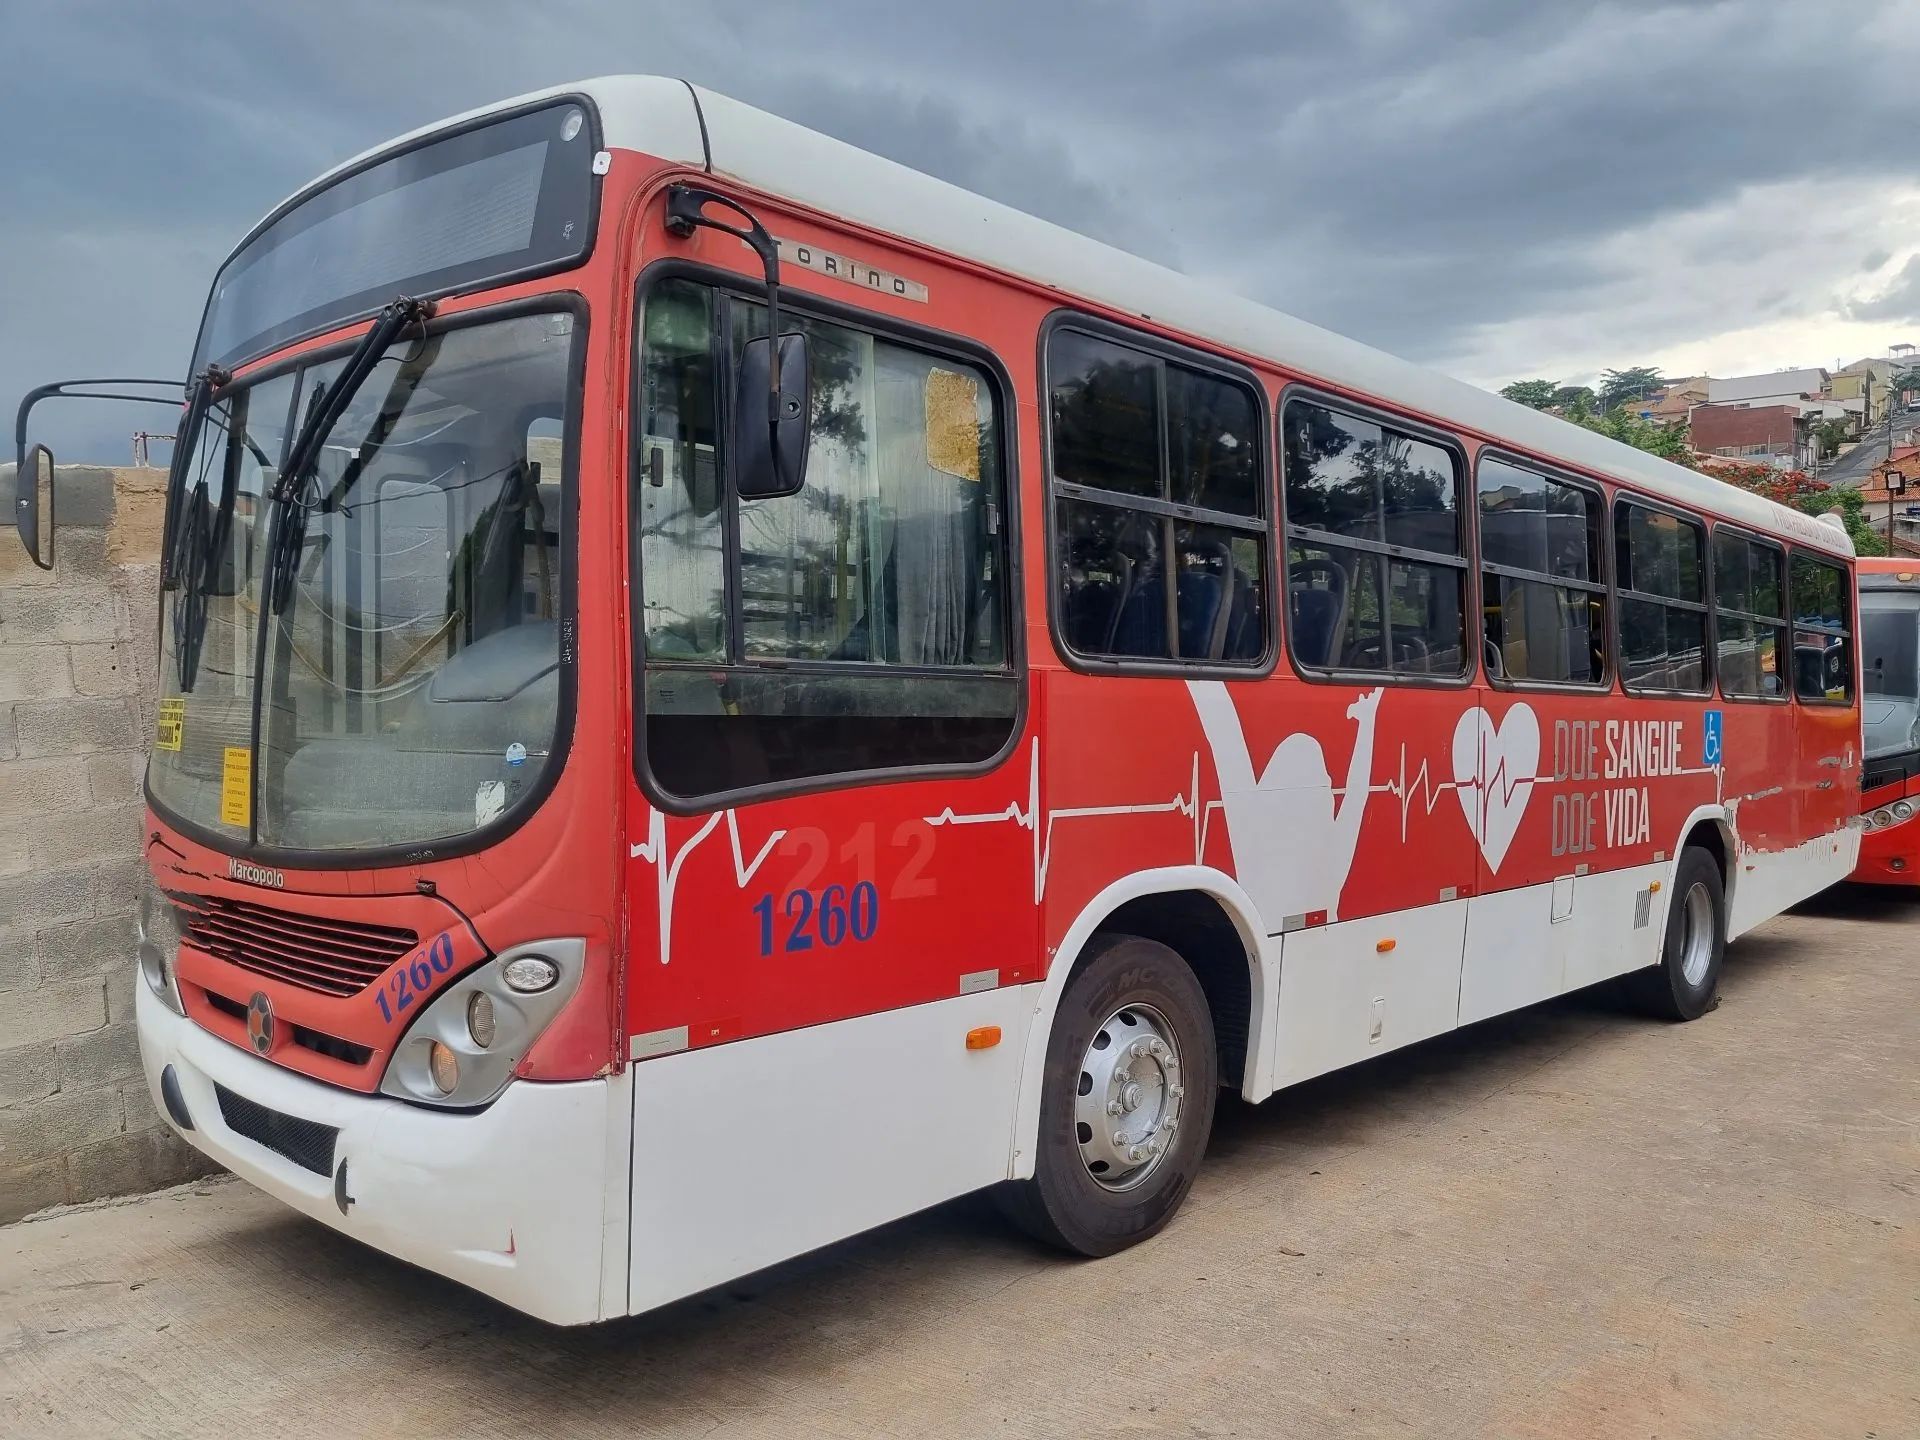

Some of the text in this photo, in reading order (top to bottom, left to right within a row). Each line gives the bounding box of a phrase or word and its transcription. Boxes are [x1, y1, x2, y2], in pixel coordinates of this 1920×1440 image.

[775, 239, 905, 294] ORINO
[1554, 720, 1683, 782] DOE SANGUE
[1552, 787, 1650, 856] DOE VIDA
[229, 857, 284, 888] Marcopolo
[776, 819, 937, 913] 212
[753, 881, 878, 957] 1260
[375, 932, 454, 1024] 1260
